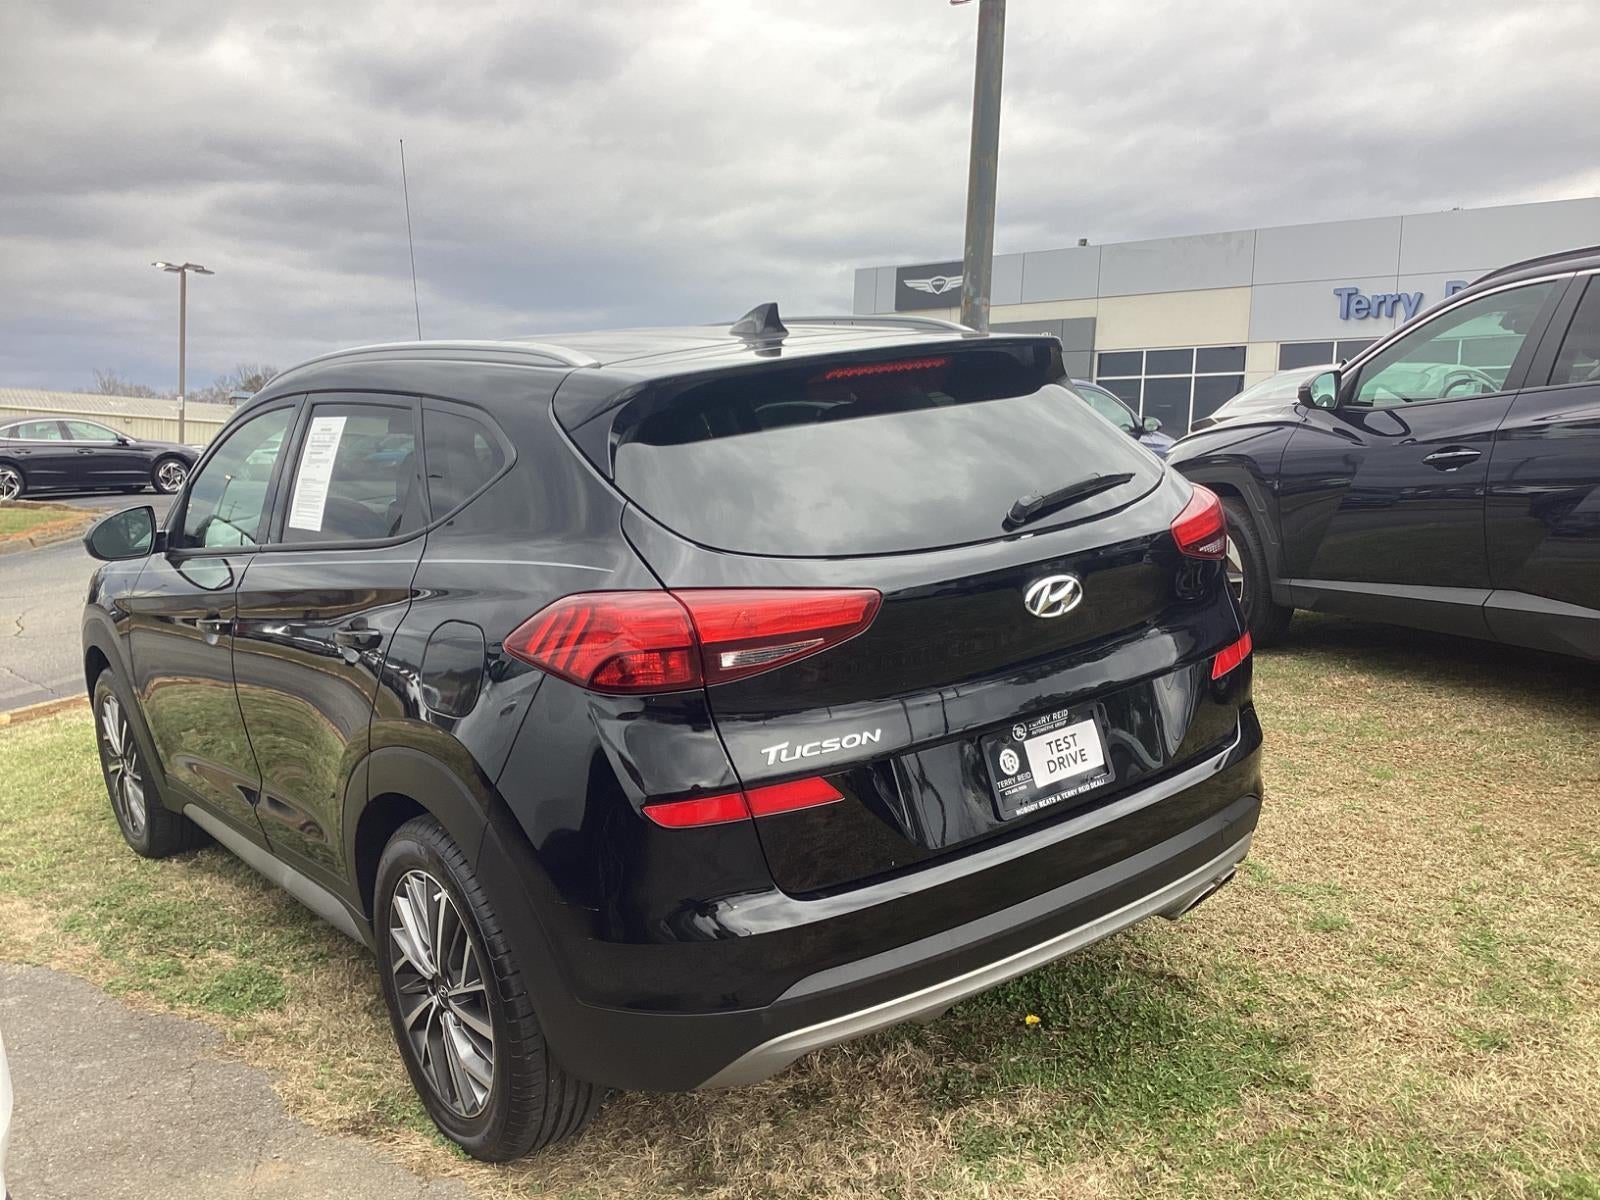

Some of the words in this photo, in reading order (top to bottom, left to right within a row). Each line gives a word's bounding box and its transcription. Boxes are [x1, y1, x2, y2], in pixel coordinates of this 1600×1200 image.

[1333, 287, 1424, 323] Terry
[1052, 709, 1069, 721] REID
[760, 728, 882, 766] TUCSON
[1045, 733, 1078, 755] TEST
[1046, 748, 1088, 774] DRIVE
[997, 776, 1016, 789] TERRY
[1016, 771, 1032, 782] REID
[1016, 802, 1038, 816] NOBODY
[1038, 797, 1056, 808] BEATS
[1061, 789, 1078, 799] TERRY
[1077, 784, 1090, 794] REID
